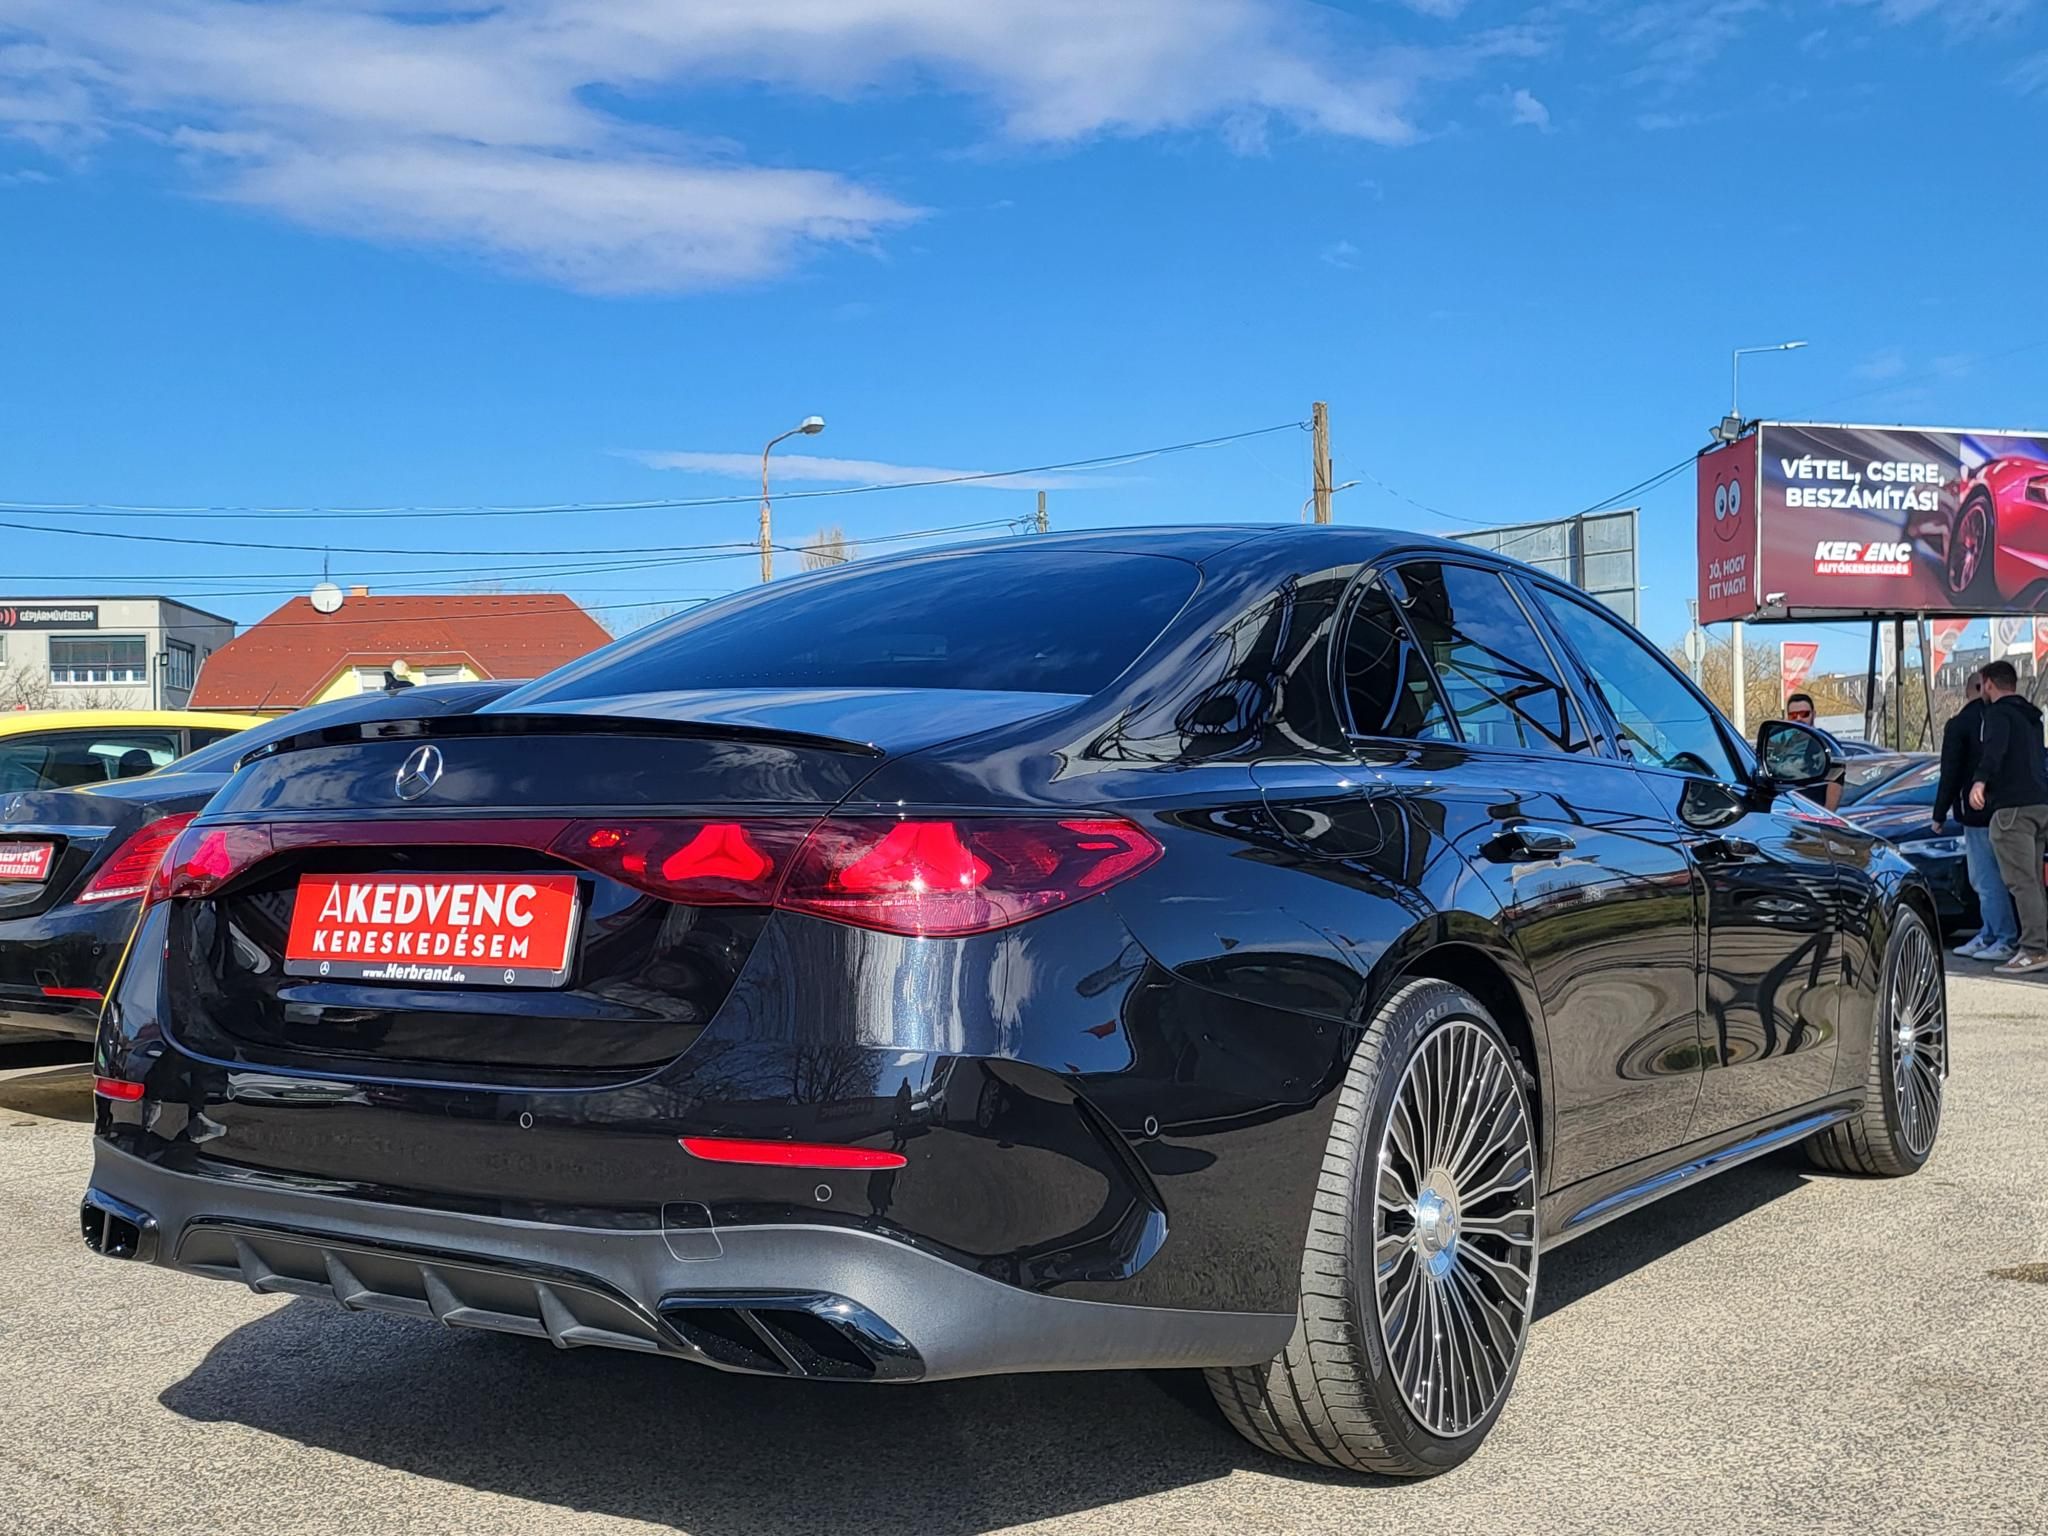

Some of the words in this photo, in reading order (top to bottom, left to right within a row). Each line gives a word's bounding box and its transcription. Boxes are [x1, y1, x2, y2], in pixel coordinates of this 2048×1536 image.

[1781, 454, 1861, 484] VÉTEL,
[1866, 461, 1945, 487] CSERE,
[1786, 483, 1939, 511] BESZÁMÍTÁS!
[1709, 558, 1722, 580] JÓ,
[1723, 554, 1746, 577] HOGY
[1817, 561, 1909, 576] AUTÓKERESKEDÉS
[1709, 582, 1721, 601] ITT
[1722, 576, 1746, 597] VAGY!
[312, 927, 529, 958] KERESKEDÉSEM
[362, 963, 465, 982] www.Herbrand.de
[1404, 1002, 1449, 1054] ZERO
